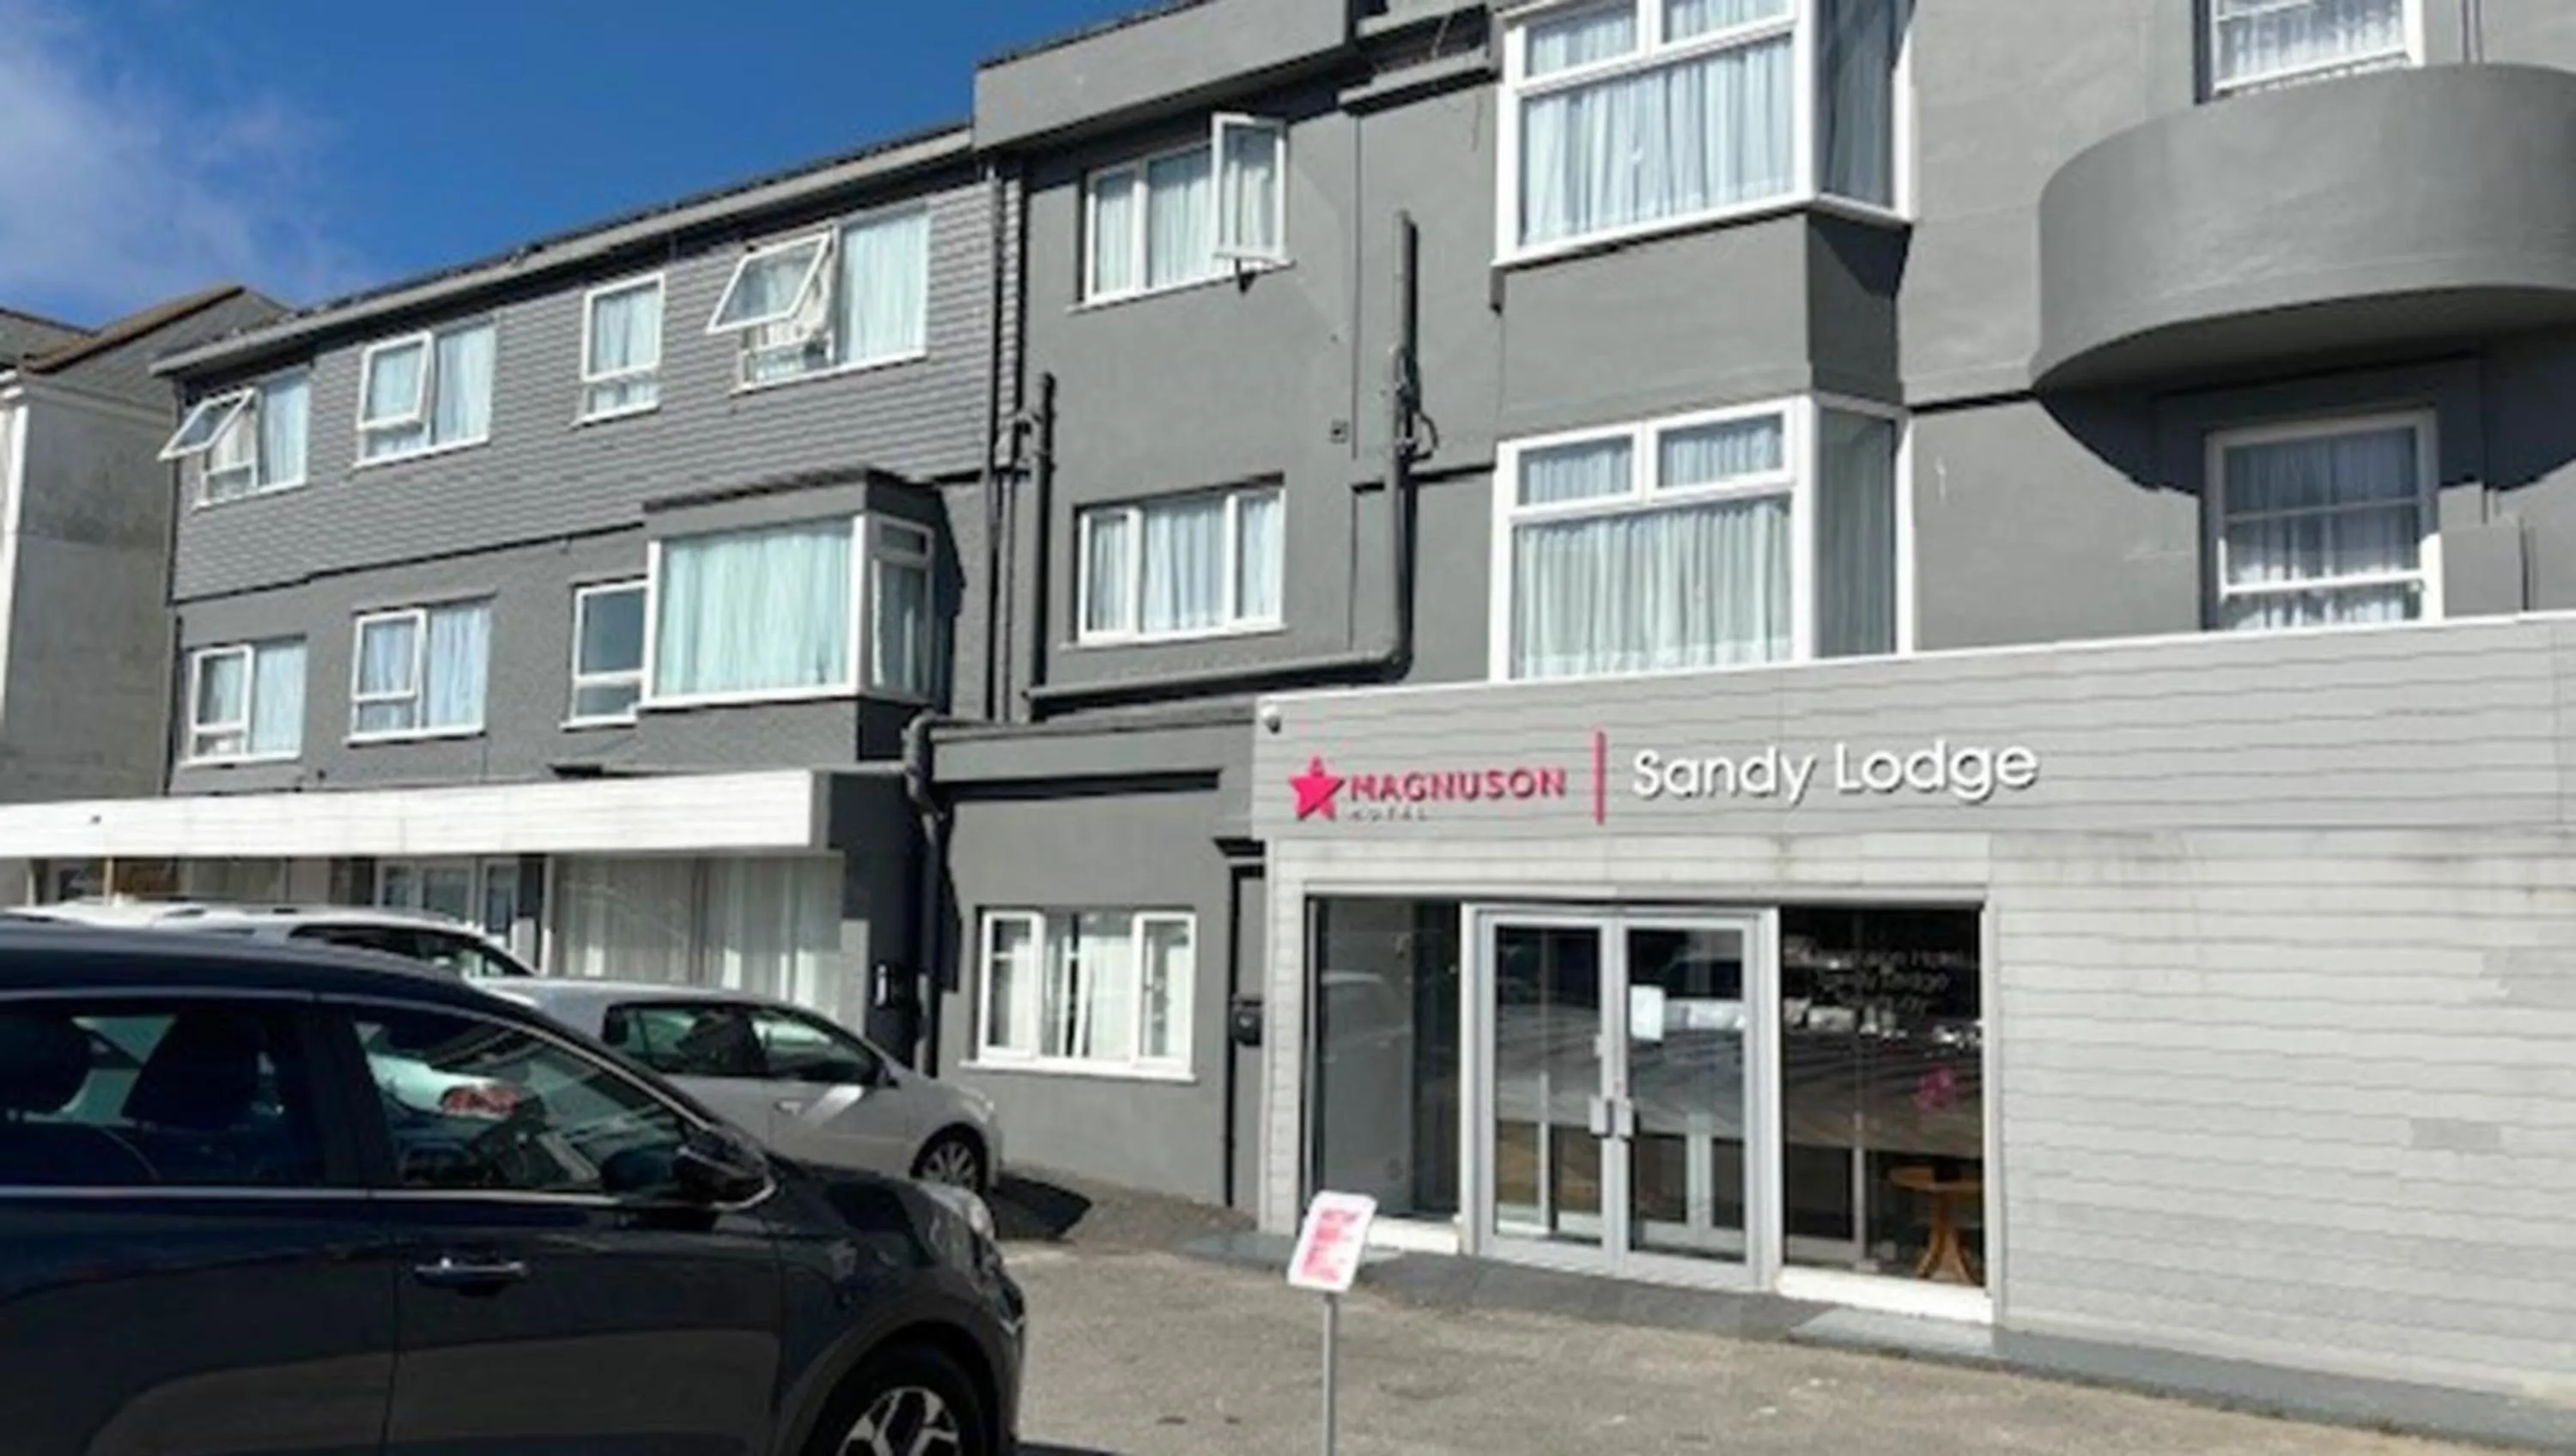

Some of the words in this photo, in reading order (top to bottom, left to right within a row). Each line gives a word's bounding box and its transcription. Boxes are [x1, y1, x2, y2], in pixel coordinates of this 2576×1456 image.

[1351, 768, 1566, 802] MAGNUSON
[1632, 744, 1817, 806] Sandy
[1834, 736, 2040, 805] Lodge
